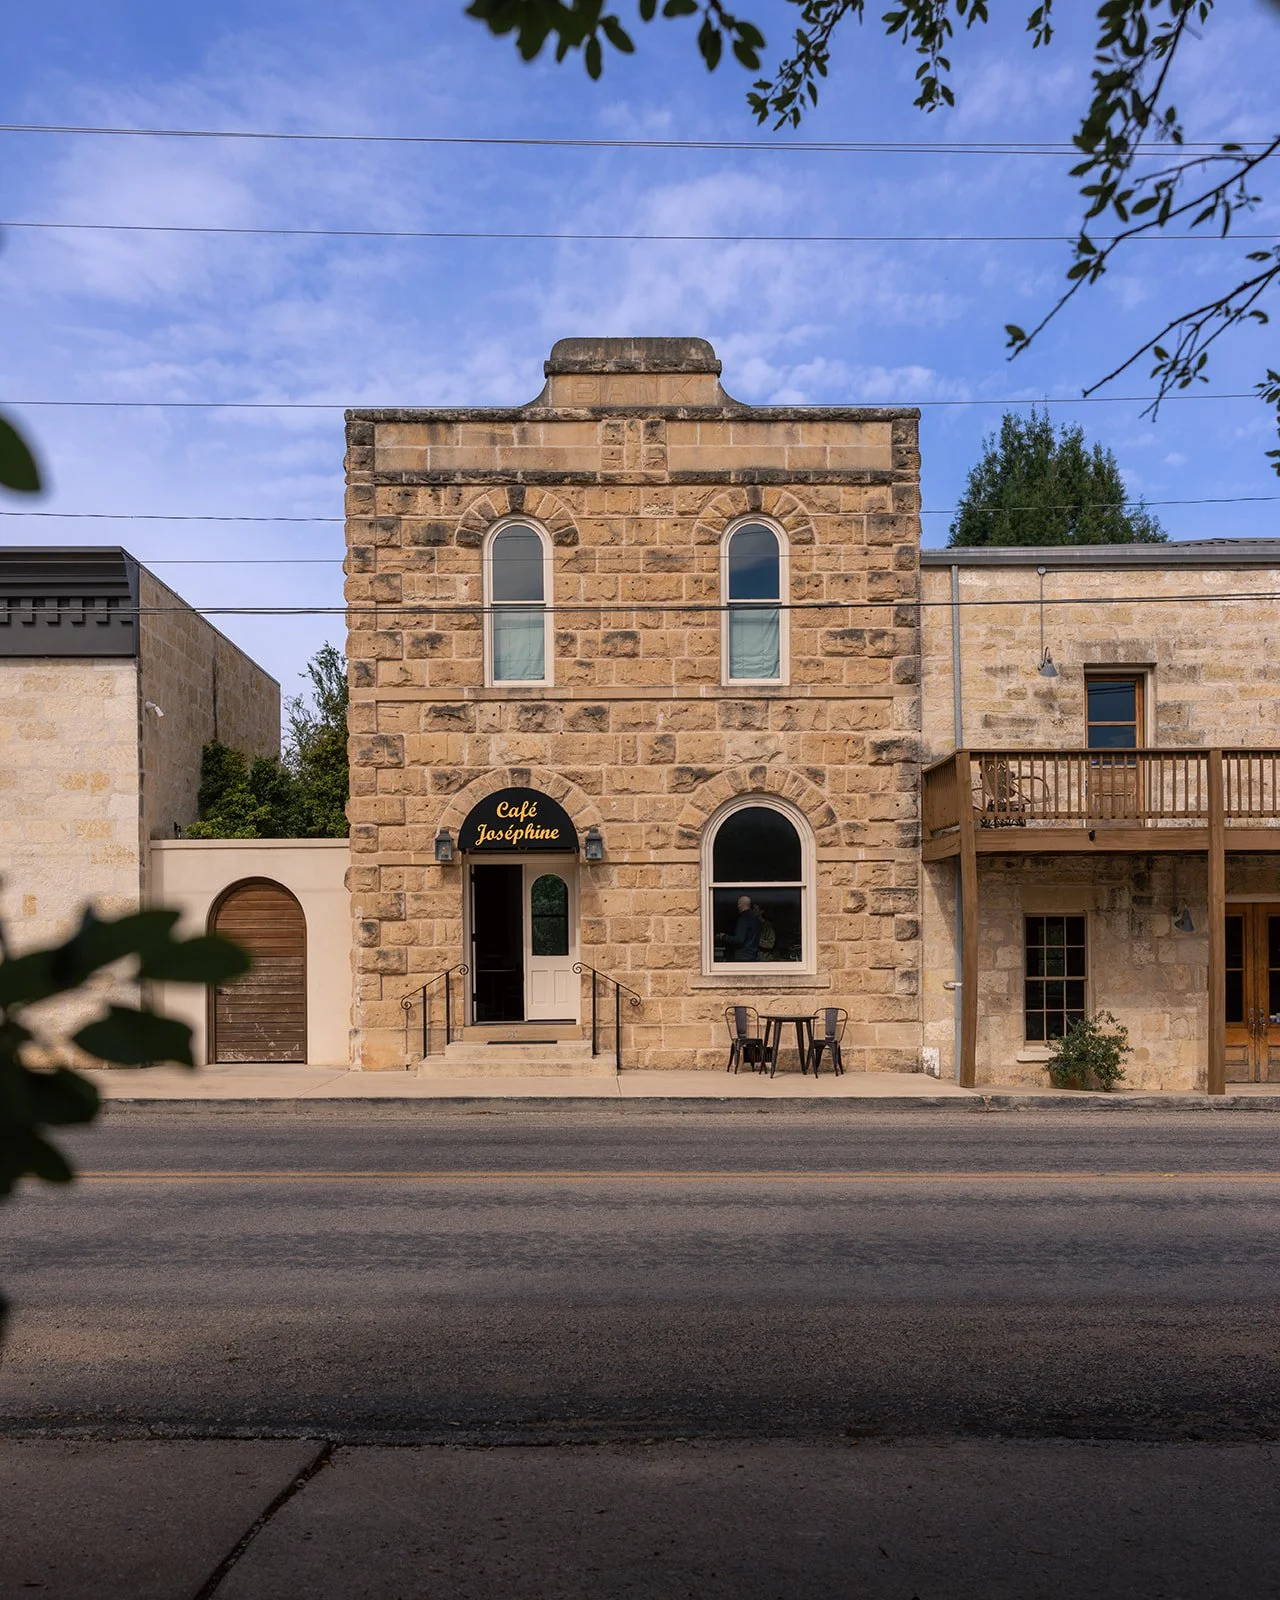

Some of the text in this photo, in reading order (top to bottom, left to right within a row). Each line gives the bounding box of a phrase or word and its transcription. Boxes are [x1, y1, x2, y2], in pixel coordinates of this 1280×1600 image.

[572, 376, 694, 404] BANK
[496, 800, 538, 823] Café
[474, 822, 560, 846] Joséphine
